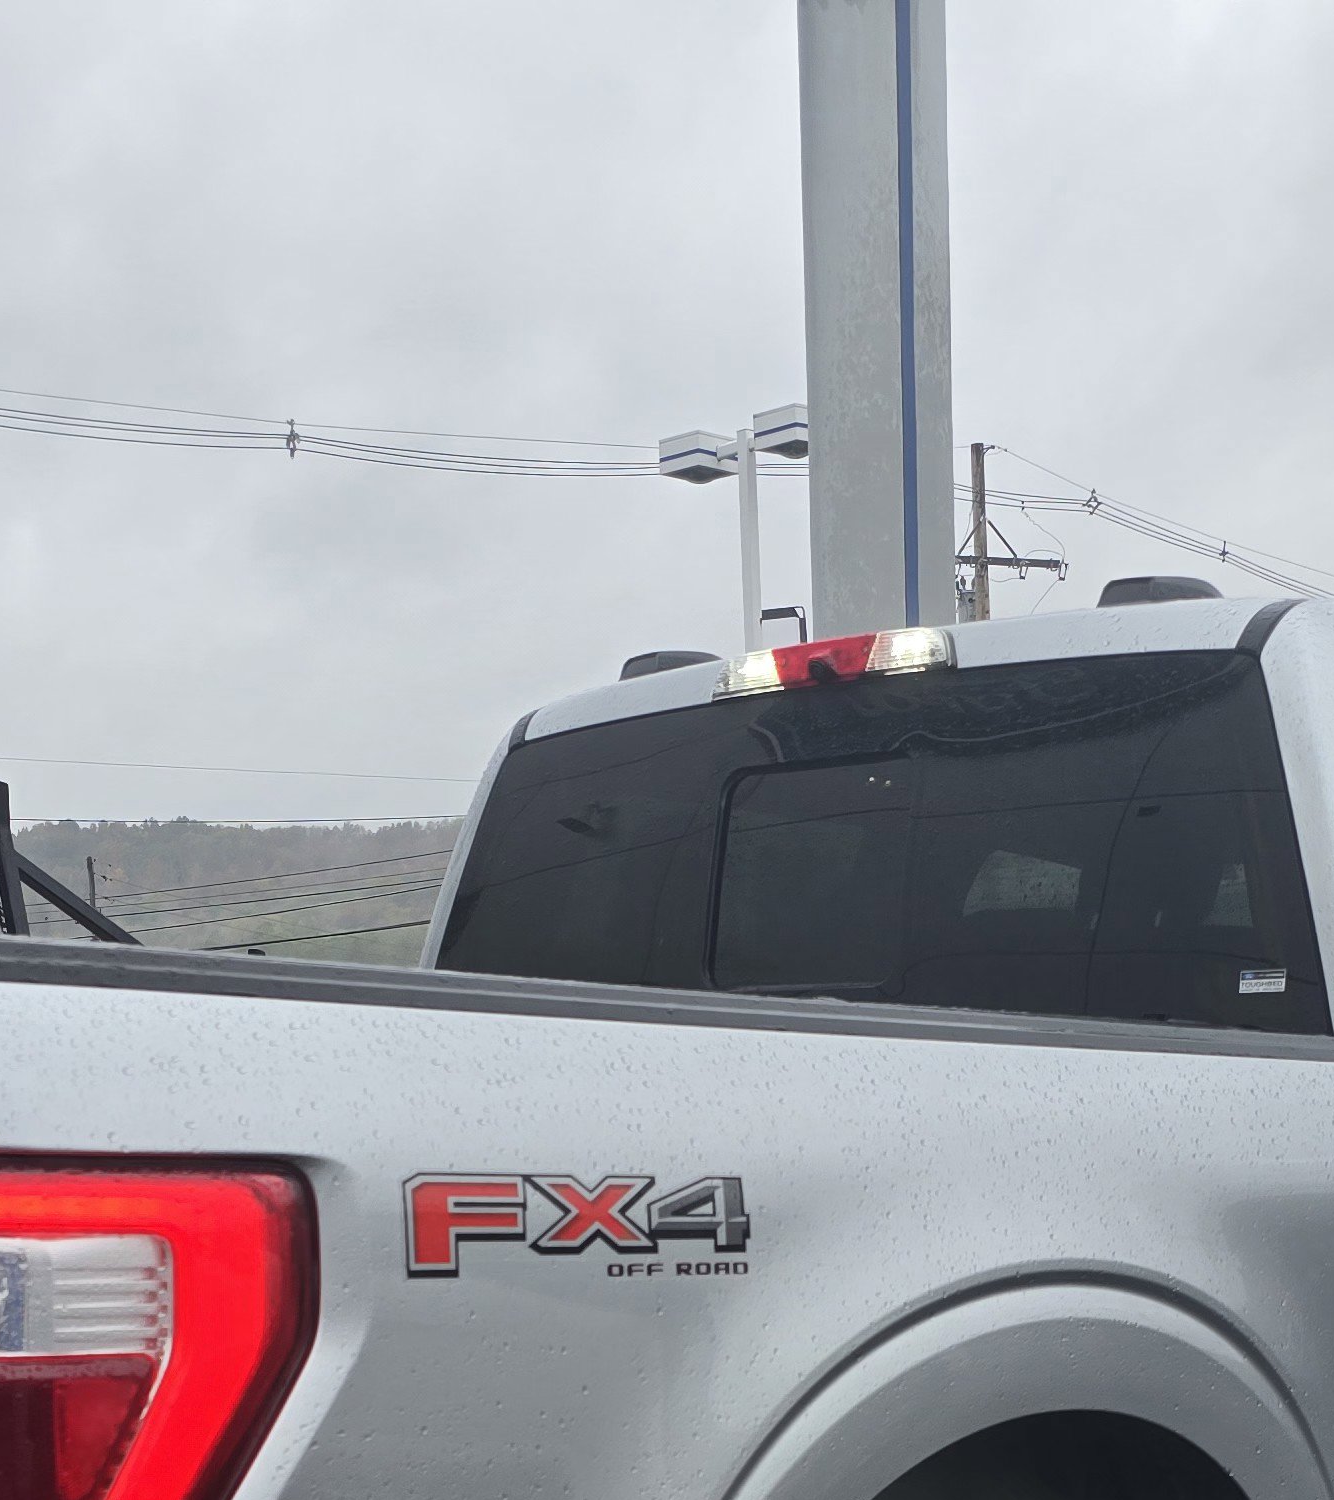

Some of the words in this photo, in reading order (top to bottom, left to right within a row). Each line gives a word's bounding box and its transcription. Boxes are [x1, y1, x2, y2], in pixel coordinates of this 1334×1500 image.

[402, 1173, 750, 1279] FX4
[607, 1262, 664, 1278] OFF
[676, 1261, 750, 1276] ROAD
